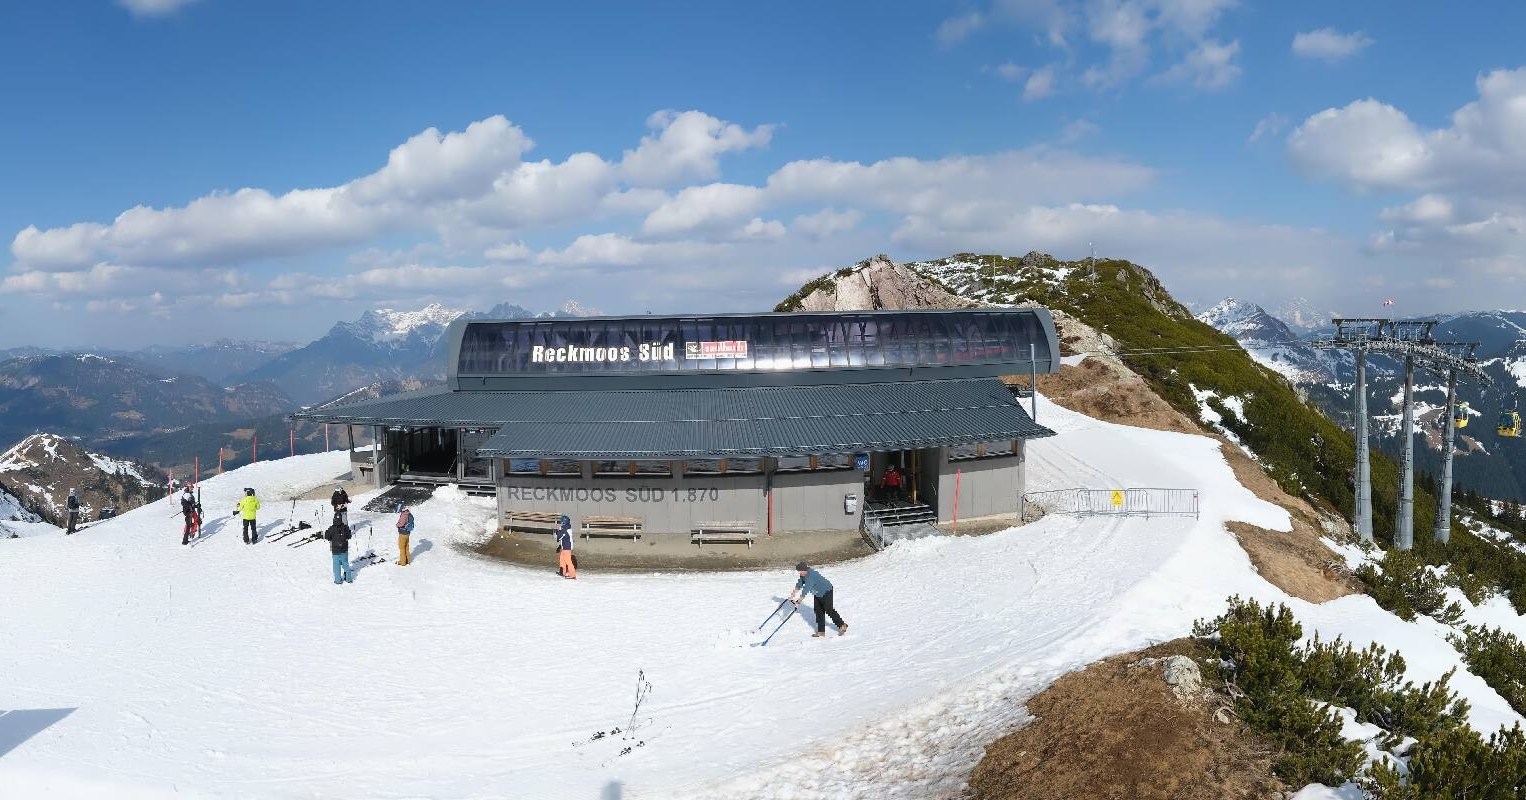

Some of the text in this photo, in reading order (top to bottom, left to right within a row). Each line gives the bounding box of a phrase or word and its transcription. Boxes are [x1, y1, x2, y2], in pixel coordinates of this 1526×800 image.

[532, 341, 674, 362] Reckmoos Süd
[507, 484, 719, 502] RECKMOOS SÜD 1.870
